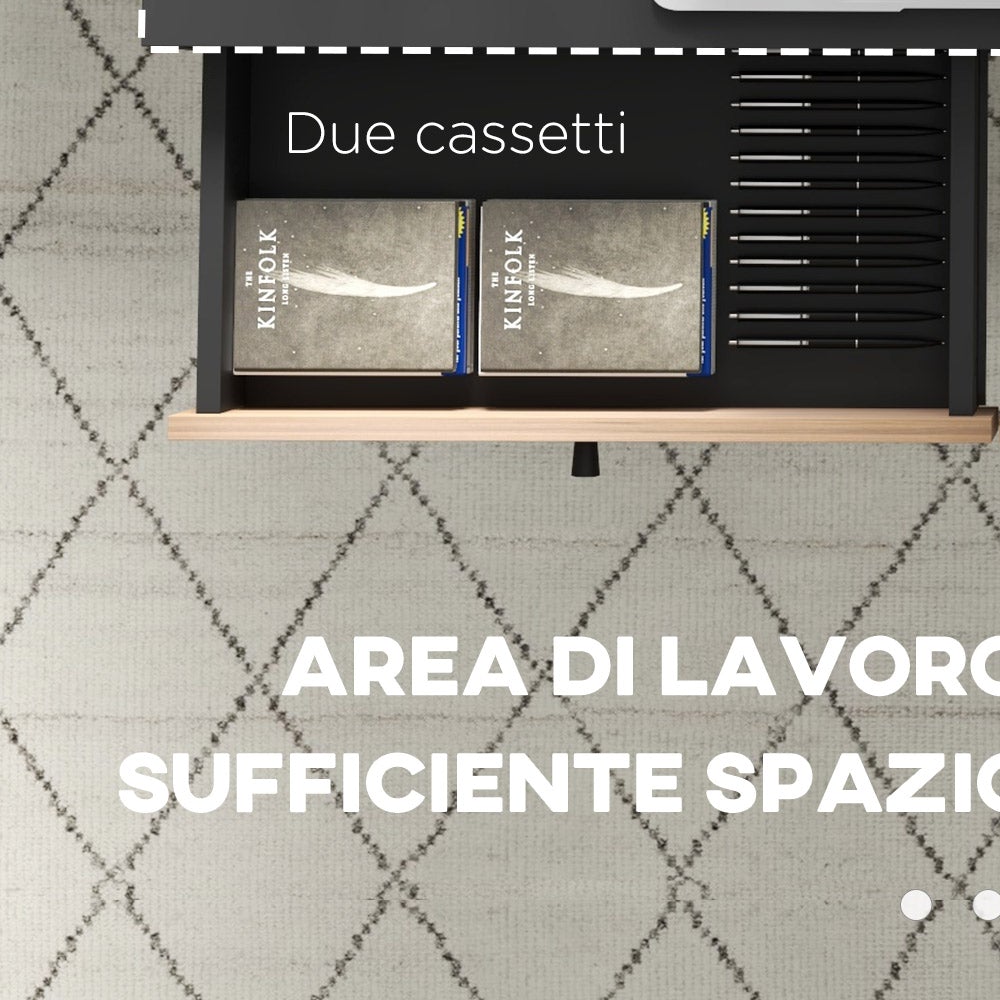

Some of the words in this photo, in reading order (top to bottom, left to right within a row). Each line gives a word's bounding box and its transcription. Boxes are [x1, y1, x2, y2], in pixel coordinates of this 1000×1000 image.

[245, 271, 253, 287] THE
[257, 228, 277, 330] KINFOLK
[490, 272, 498, 288] THE
[502, 229, 522, 331] KINFOLK
